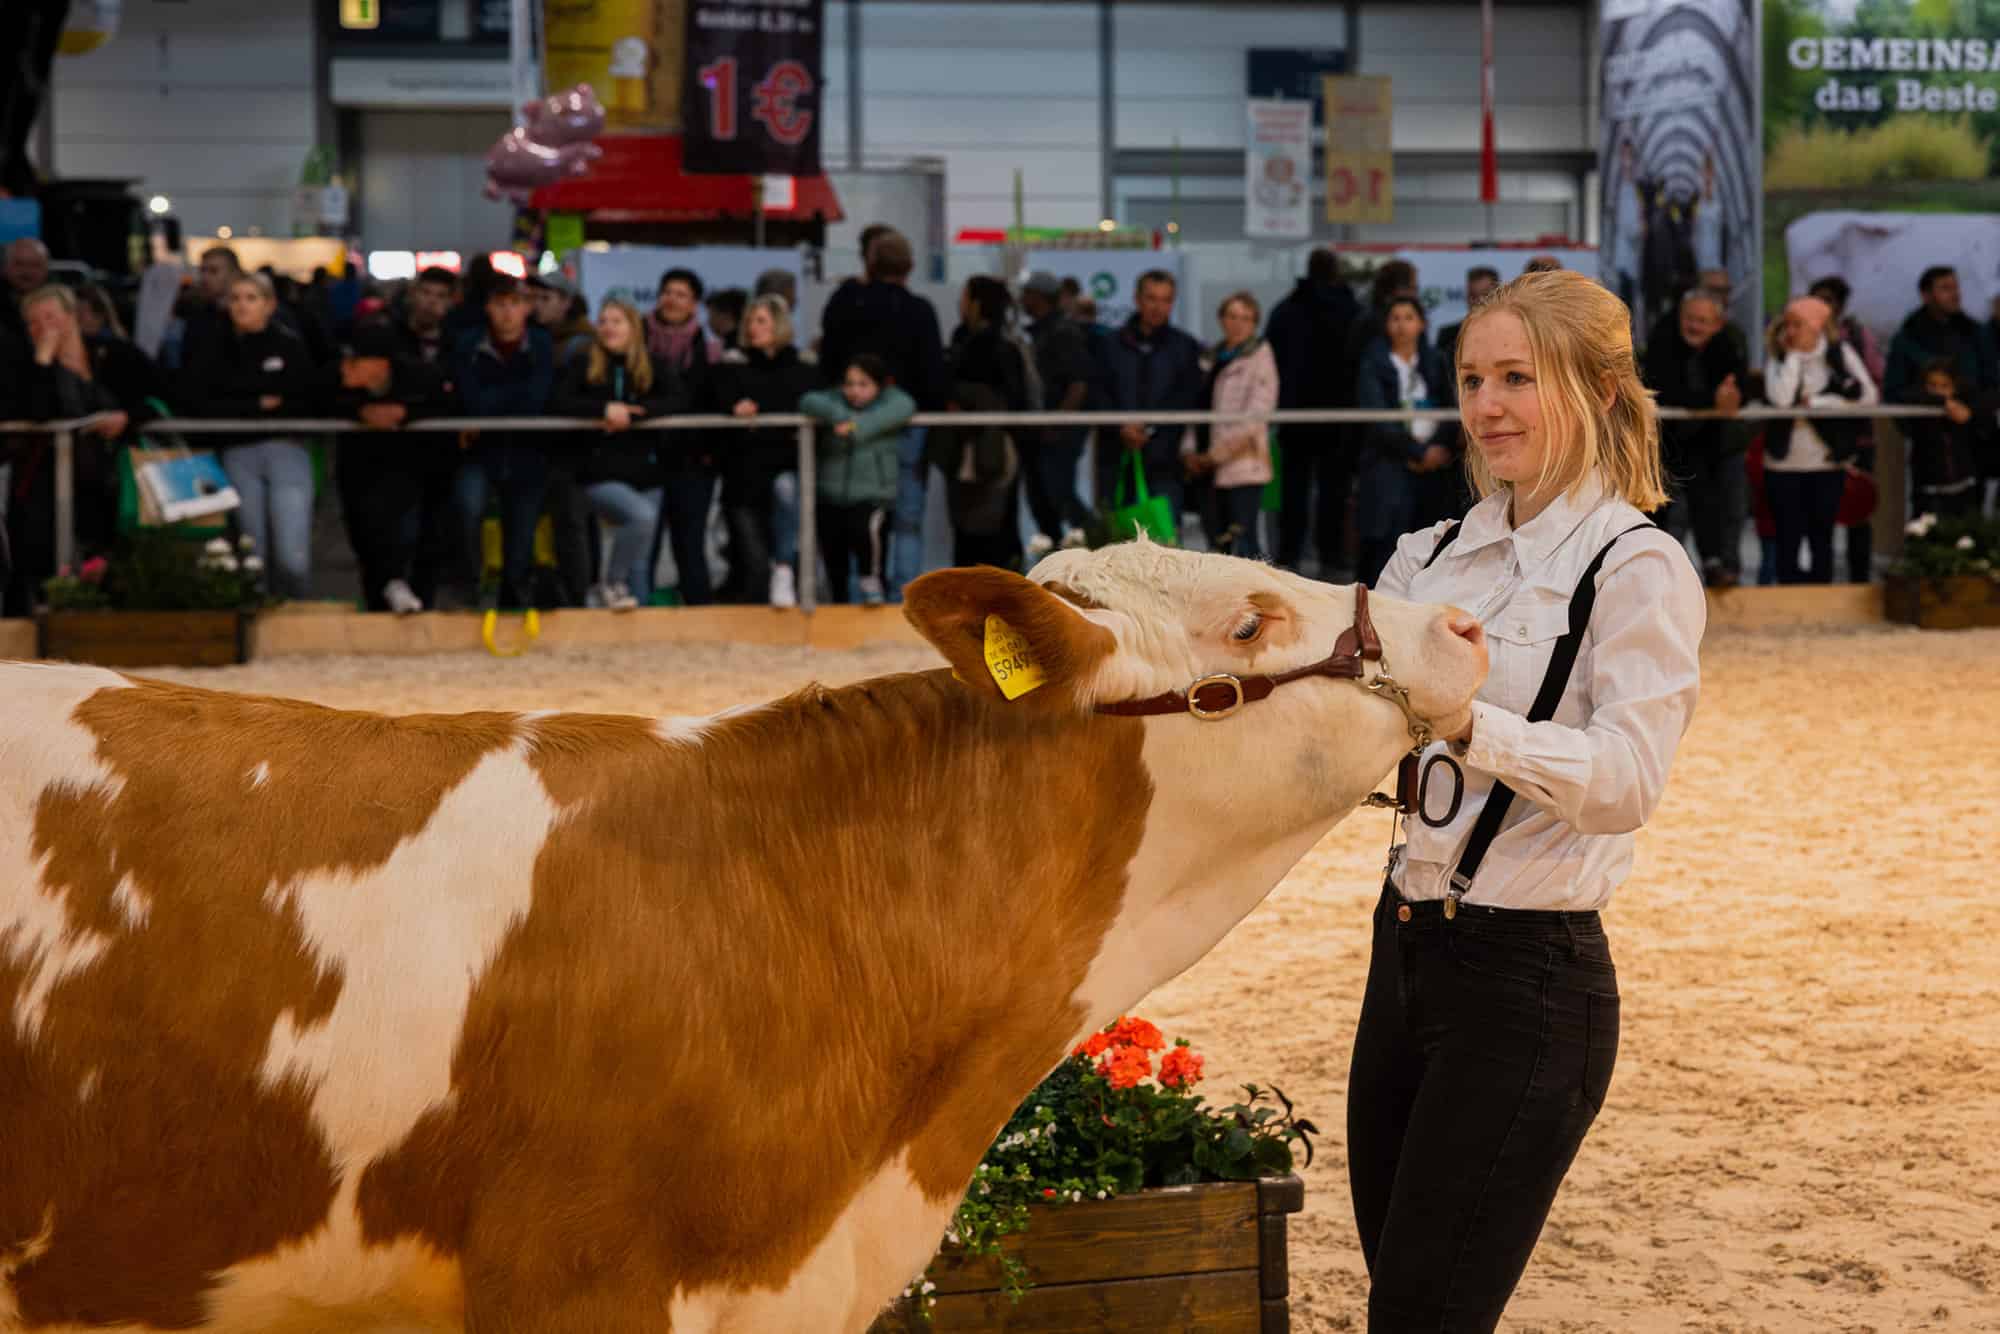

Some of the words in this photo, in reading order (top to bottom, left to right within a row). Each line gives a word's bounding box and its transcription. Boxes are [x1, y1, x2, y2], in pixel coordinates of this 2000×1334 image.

[699, 57, 739, 141] 1
[752, 60, 813, 144] €
[1815, 79, 1881, 111] das
[1897, 79, 1998, 111] Beste
